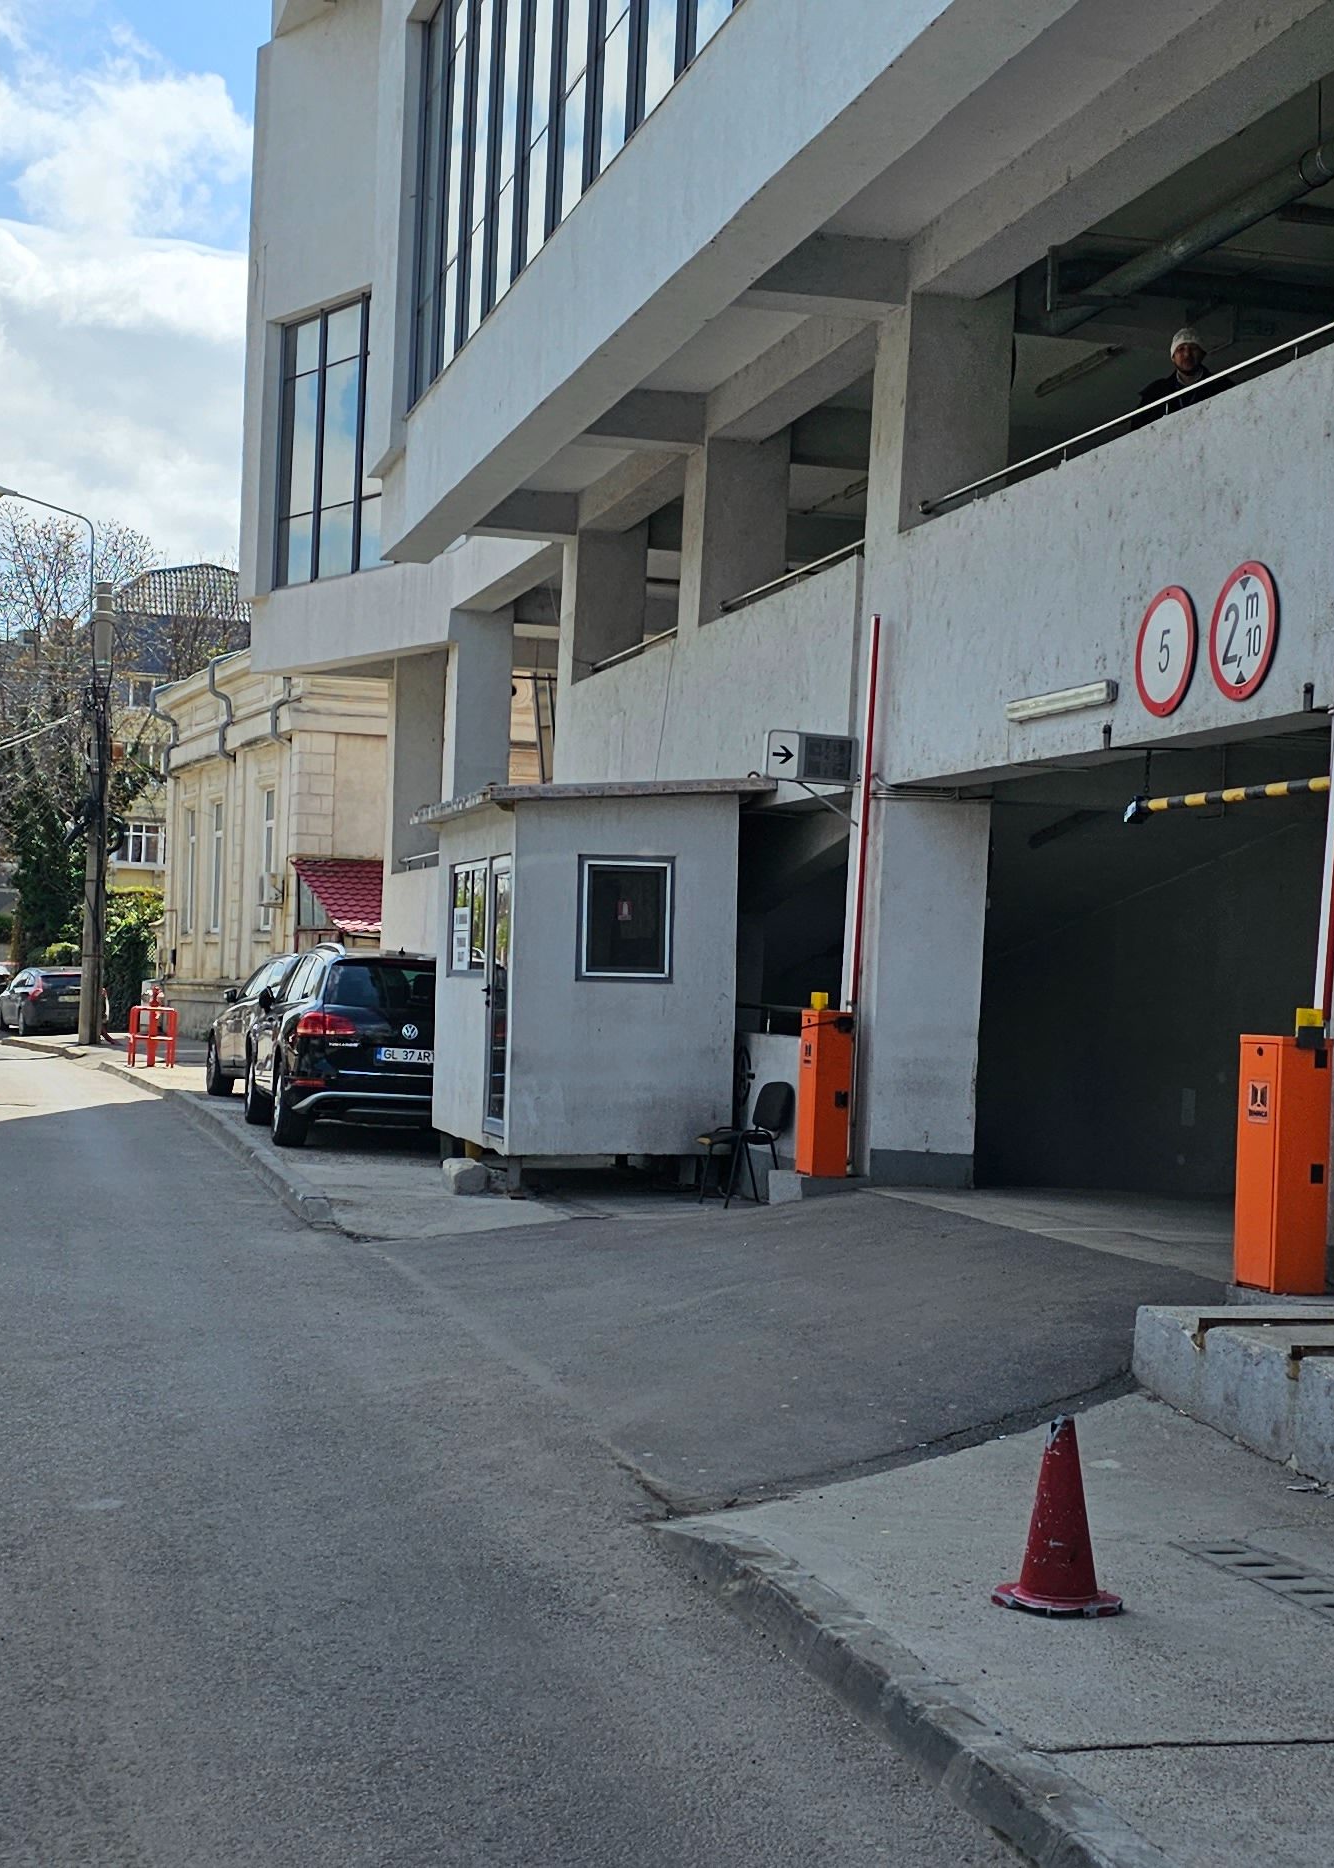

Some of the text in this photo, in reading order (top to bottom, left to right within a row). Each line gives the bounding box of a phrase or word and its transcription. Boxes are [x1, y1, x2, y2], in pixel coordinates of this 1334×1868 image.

[1245, 591, 1259, 621] m
[1158, 628, 1171, 674] 5
[384, 1050, 398, 1060] GL
[402, 1051, 415, 1061] 37
